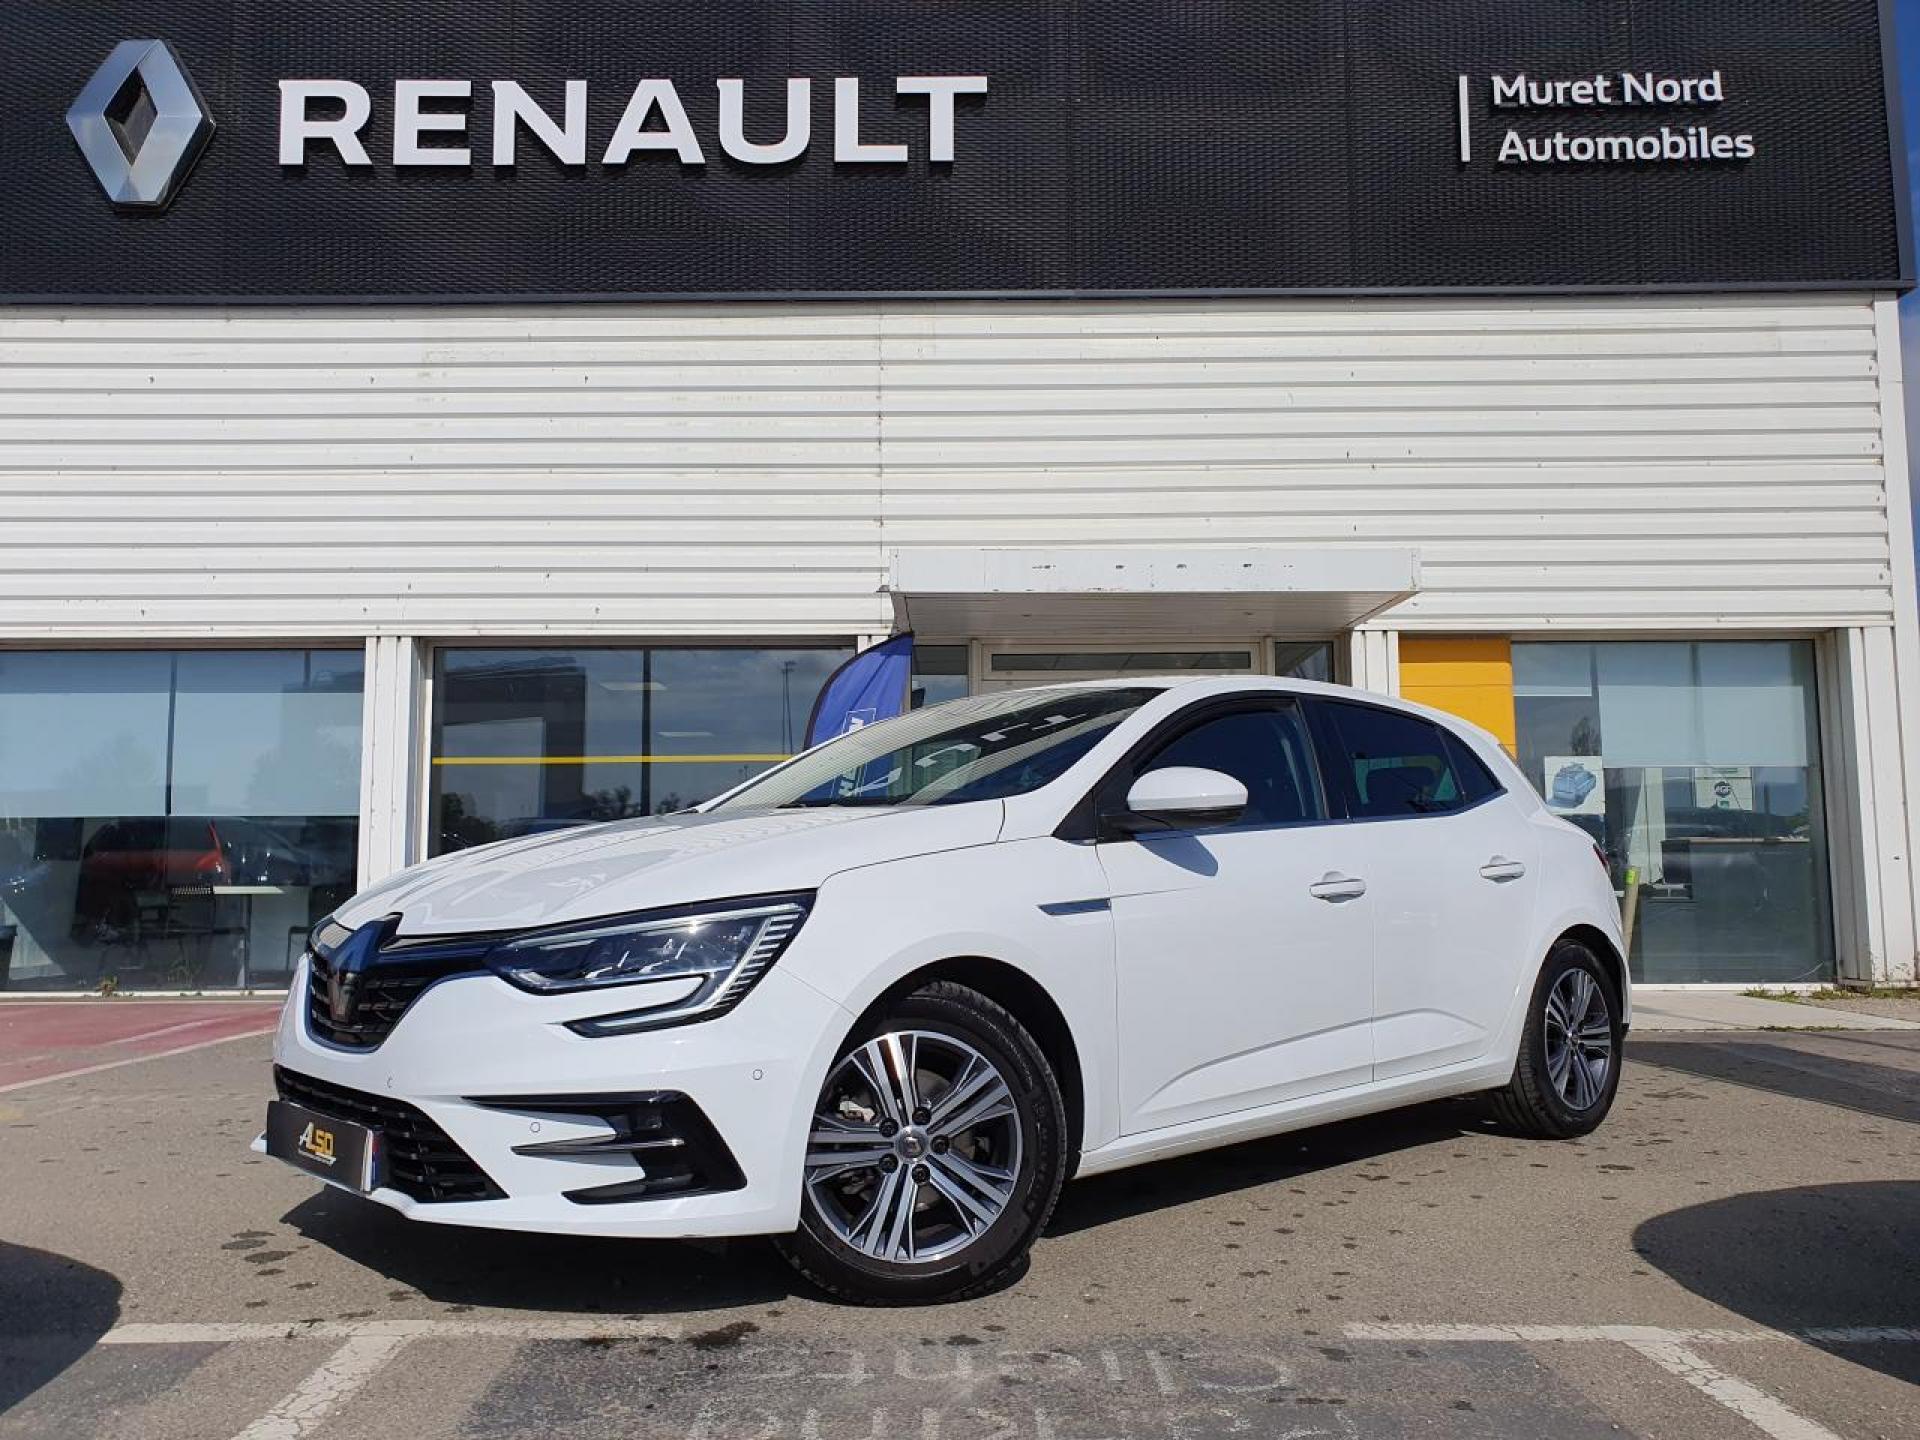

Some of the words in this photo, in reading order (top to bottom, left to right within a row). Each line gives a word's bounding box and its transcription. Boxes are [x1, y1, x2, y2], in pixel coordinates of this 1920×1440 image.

[1490, 74, 1612, 105] Muret
[1621, 70, 1725, 103] Nord
[278, 75, 988, 166] RENAULT
[1497, 126, 1756, 162] Automobiles
